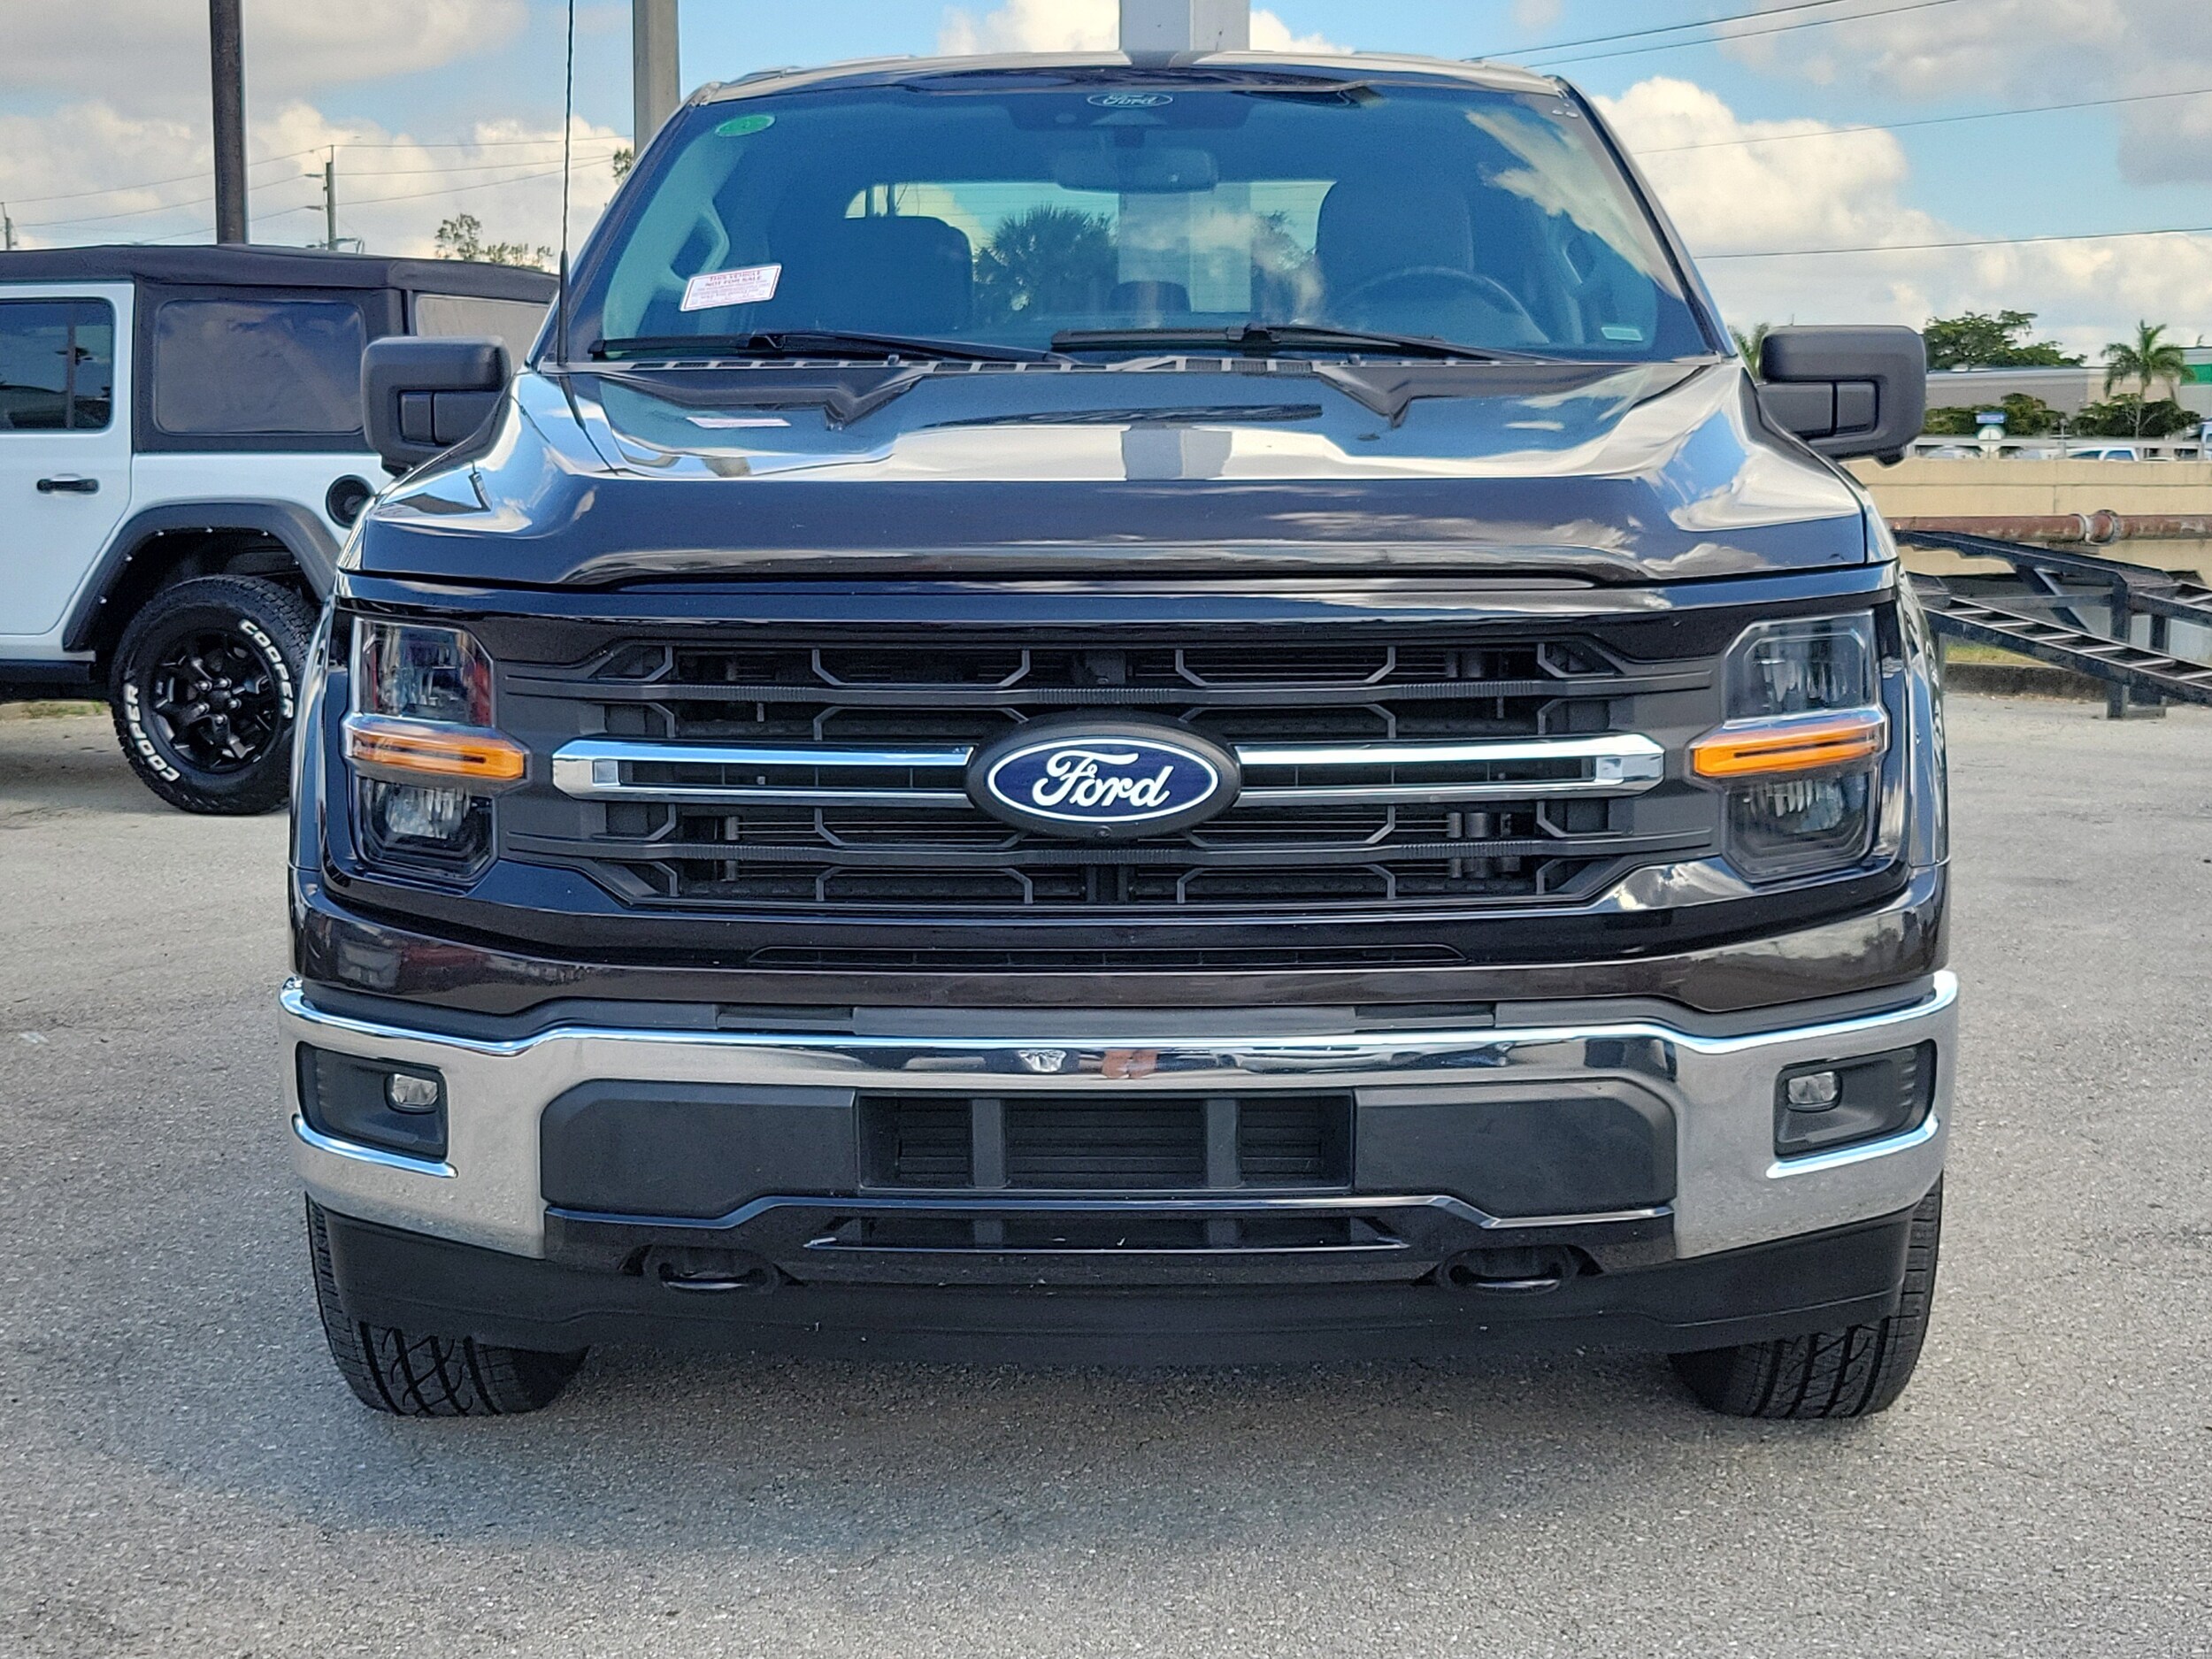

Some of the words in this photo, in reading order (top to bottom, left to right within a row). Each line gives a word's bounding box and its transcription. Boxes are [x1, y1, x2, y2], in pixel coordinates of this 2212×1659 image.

[1102, 94, 1157, 105] Ford
[240, 619, 294, 718] COOPER
[124, 682, 180, 781] COOPER
[1032, 750, 1173, 807] Ford
